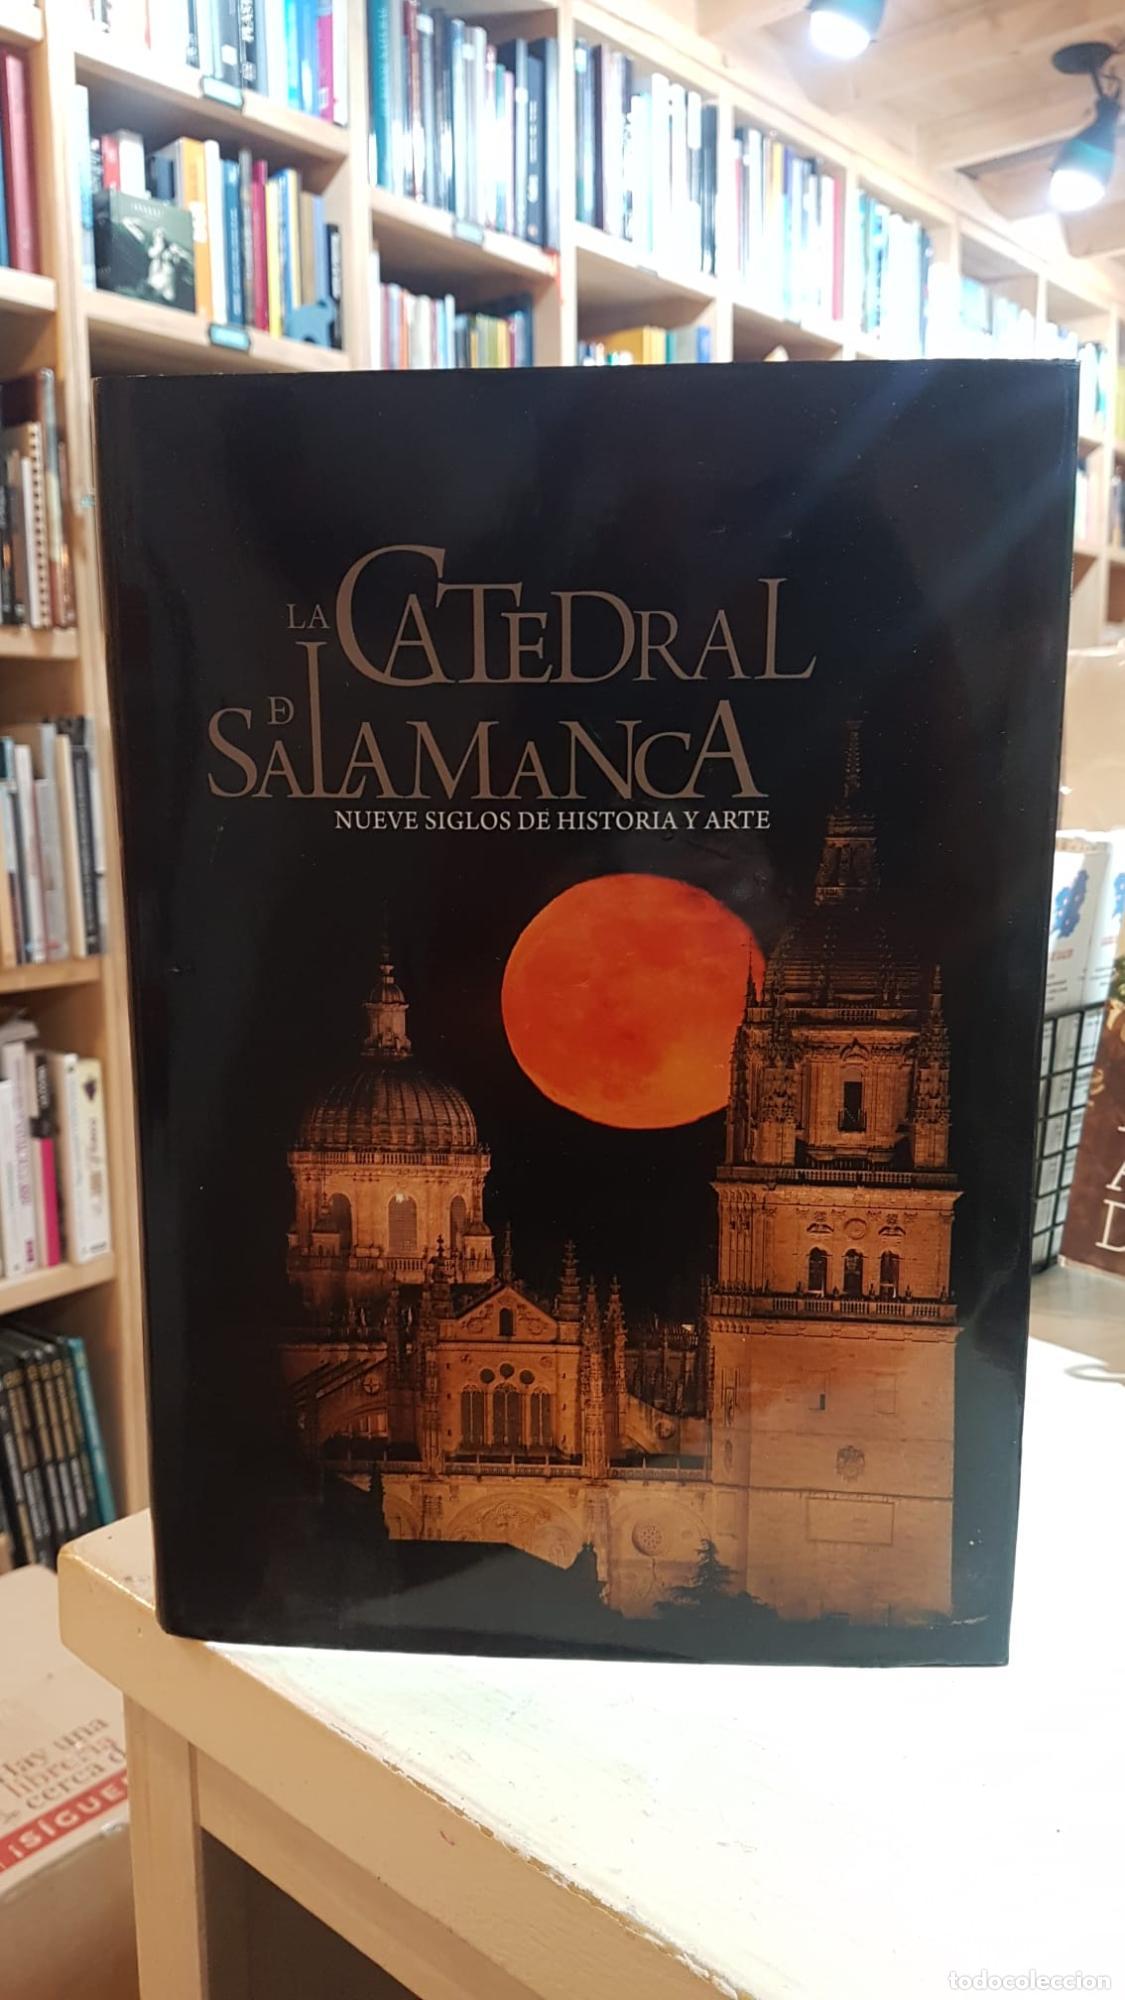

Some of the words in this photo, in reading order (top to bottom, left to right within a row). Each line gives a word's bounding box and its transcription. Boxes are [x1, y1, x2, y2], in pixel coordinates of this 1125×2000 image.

[286, 603, 331, 629] LA
[335, 543, 817, 687] CATEDRAL
[207, 640, 770, 801] SALAMANCA
[334, 810, 419, 830] NUEVE
[425, 810, 512, 830] SIGLOS
[518, 810, 552, 830] DE
[558, 810, 678, 830] HISTORIA
[683, 810, 700, 830] Y
[703, 810, 771, 830] ARTE
[25, 1764, 105, 1811] cerca
